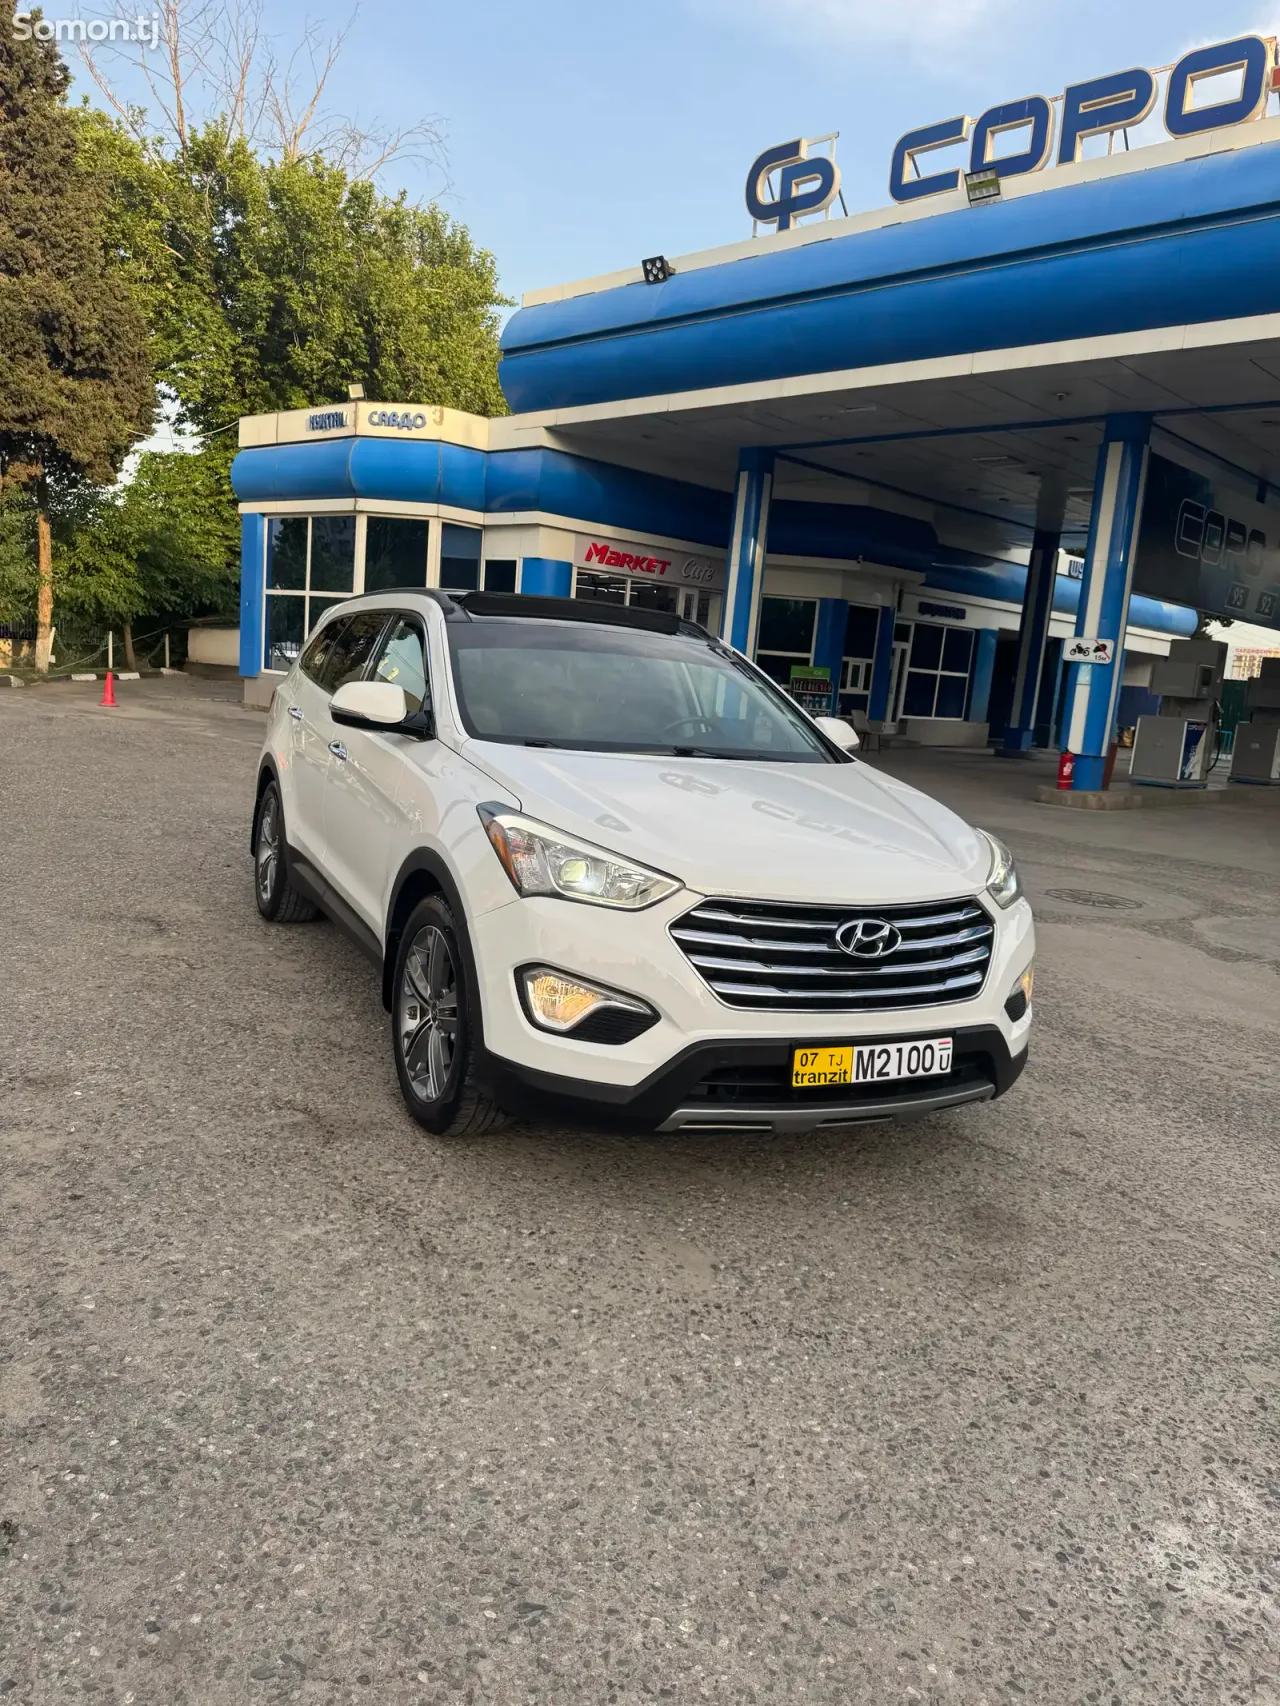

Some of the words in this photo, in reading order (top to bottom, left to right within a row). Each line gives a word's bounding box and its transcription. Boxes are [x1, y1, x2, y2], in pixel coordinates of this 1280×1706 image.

[367, 410, 427, 430] САВДО
[681, 557, 716, 583] Cafe
[1260, 594, 1272, 613] 92
[800, 1053, 818, 1067] 07
[828, 1054, 843, 1067] TJ
[855, 1044, 935, 1080] M2100
[939, 1053, 950, 1071] U
[794, 1069, 848, 1084] tranzit
